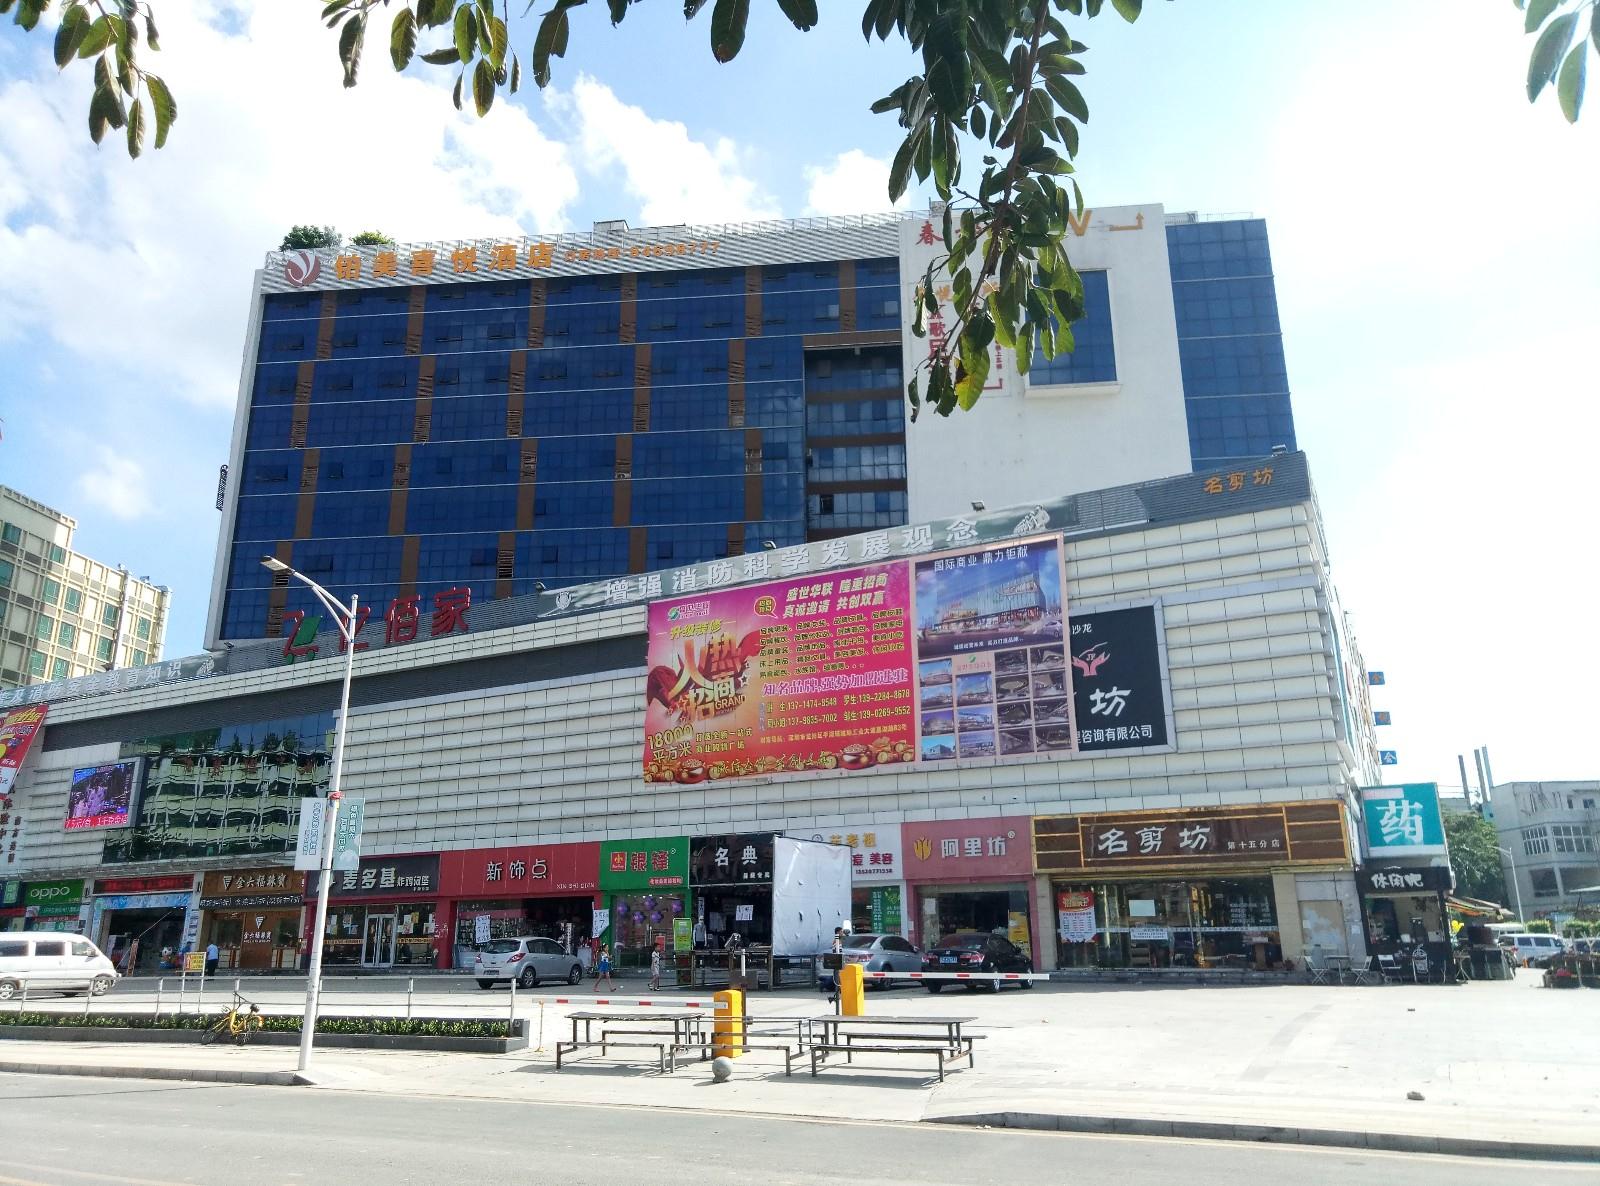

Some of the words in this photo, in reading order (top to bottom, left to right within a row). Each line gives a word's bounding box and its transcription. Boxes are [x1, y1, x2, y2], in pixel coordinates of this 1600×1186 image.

[334, 242, 555, 281] 铂美喜悦酒店
[1203, 465, 1274, 495] 名剪坊
[603, 517, 979, 606] 增强消防科学发展观念
[934, 555, 977, 572] 国际商业
[982, 546, 1028, 564] 鼎力钜献
[786, 581, 834, 602] 盛世华联
[1072, 623, 1093, 635] 沙龙
[1089, 686, 1132, 717] 坊
[648, 724, 694, 750] 18000
[653, 741, 692, 763] 平方米
[1376, 800, 1424, 846] 药
[940, 836, 1007, 858] 阿里坊
[1098, 825, 1211, 855] 名剪坊
[1227, 839, 1281, 850] 第十五分店
[715, 845, 758, 867] 名典
[869, 852, 893, 865] 美容
[487, 858, 547, 881] 新饰点
[1371, 872, 1424, 889] 休闲吧
